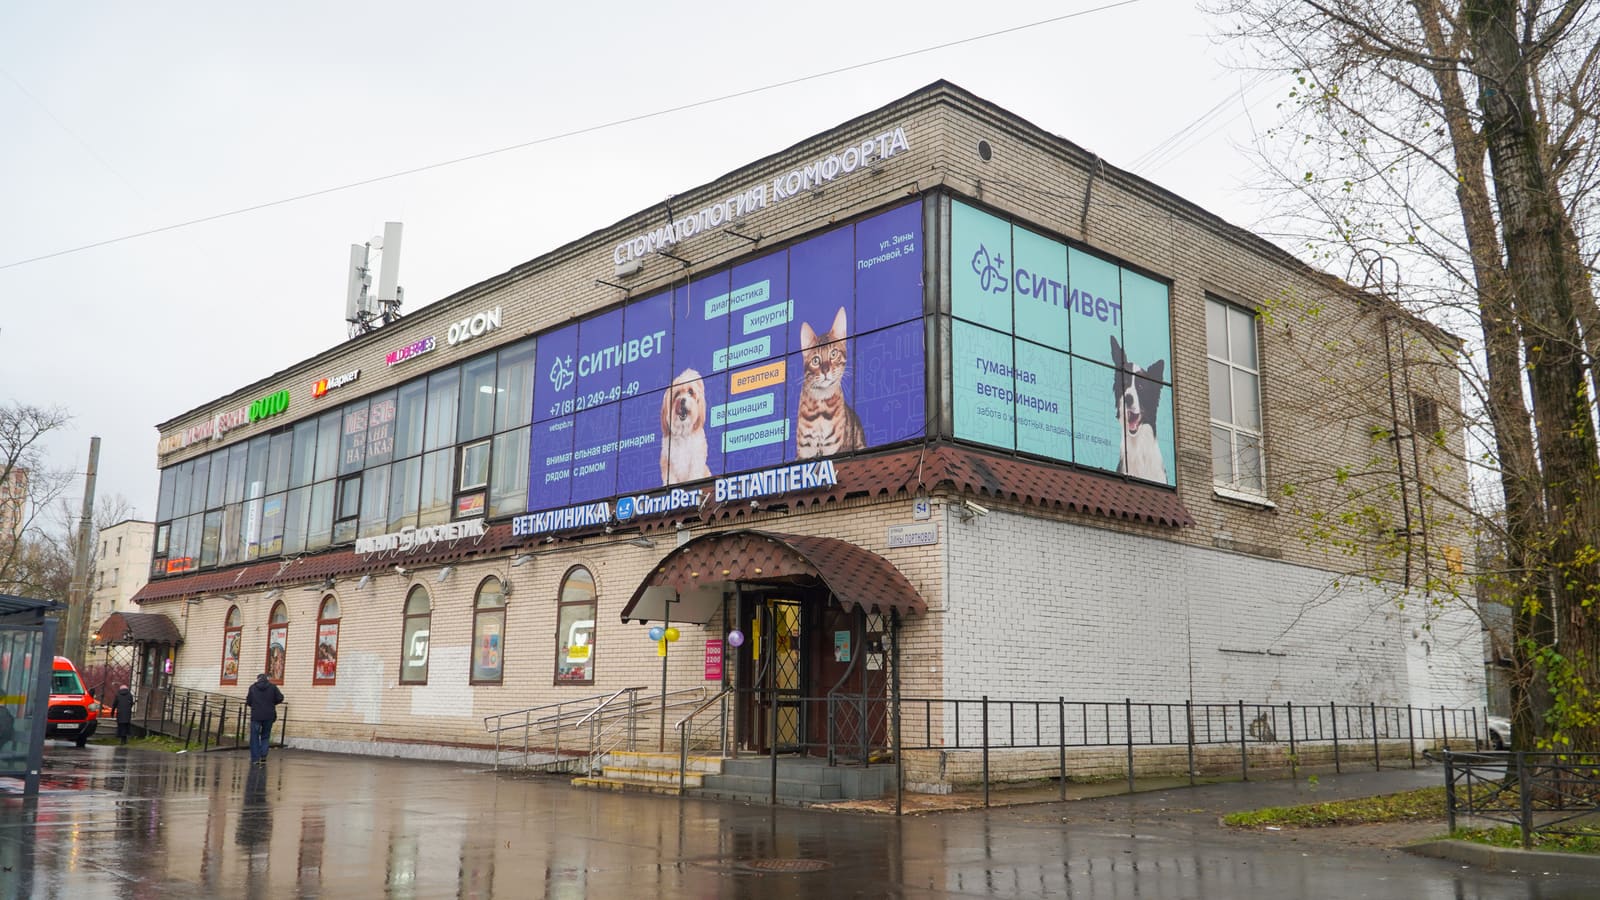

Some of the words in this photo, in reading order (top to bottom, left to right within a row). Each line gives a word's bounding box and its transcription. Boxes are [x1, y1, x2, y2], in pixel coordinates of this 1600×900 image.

[614, 184, 766, 264] СТОМАТОЛОГИЯ
[773, 127, 910, 201] КОМФОРТА
[880, 240, 891, 251] ул.
[892, 232, 914, 245] Зины
[903, 243, 914, 254] 54
[710, 288, 763, 314] диагностика
[447, 306, 502, 345] OZON
[719, 344, 764, 363] стационар
[327, 369, 361, 391] Маркет
[737, 368, 779, 387] ветаптека
[976, 357, 1037, 385] гуманная
[549, 402, 560, 416] +7
[561, 396, 585, 415] (812)
[587, 381, 639, 408] 249-49-49
[977, 382, 1059, 415] ветеринария
[716, 400, 768, 420] вакцинация
[976, 406, 1001, 420] забота
[729, 426, 785, 445] чипирование
[546, 447, 601, 466] внимательная
[602, 433, 655, 453] ветеринария
[545, 468, 570, 484] рядом
[579, 462, 606, 477] домом
[512, 502, 610, 537] ВЕТКЛИНИКА
[635, 489, 699, 515] СитиВет
[715, 460, 837, 502] ВЕТАПТЕКА
[916, 502, 927, 513] 54
